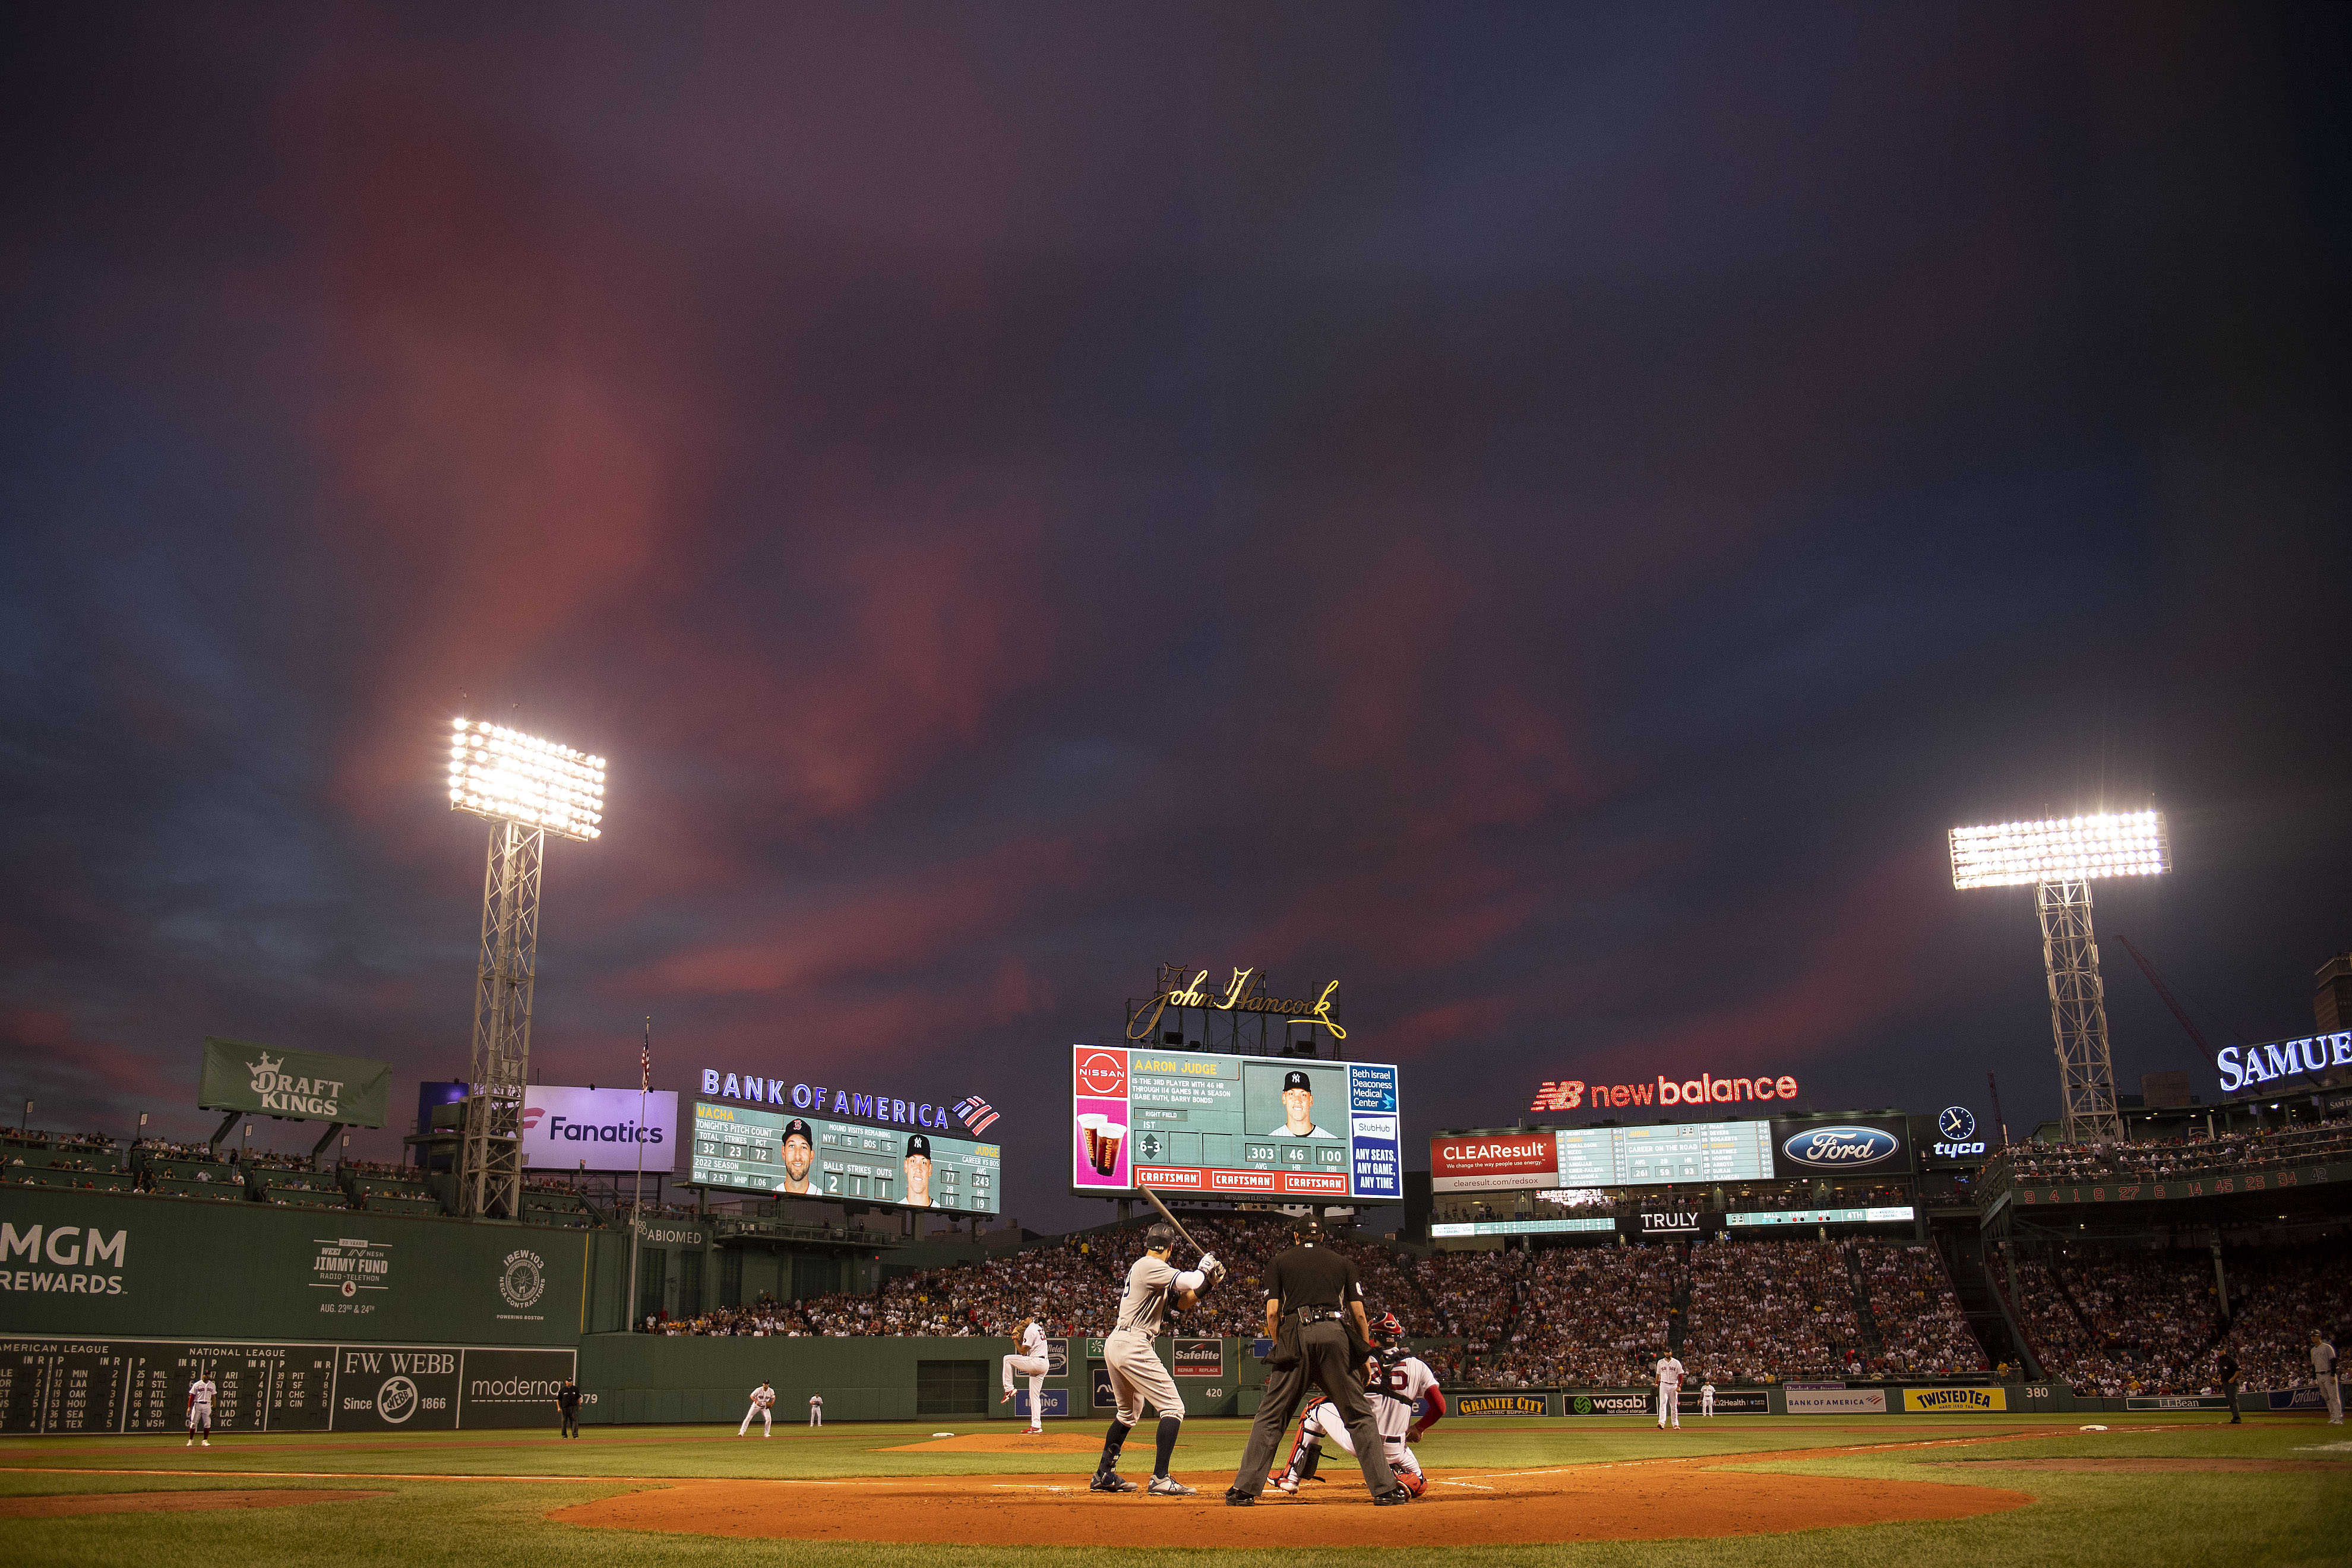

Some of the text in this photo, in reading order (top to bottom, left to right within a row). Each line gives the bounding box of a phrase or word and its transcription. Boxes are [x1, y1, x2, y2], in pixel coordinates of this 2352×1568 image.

[1127, 962, 1347, 1040] John Hancock
[1134, 1060, 1217, 1074] AARON JUDGE
[2217, 1030, 2352, 1092] SAMUE
[1079, 1069, 1125, 1077] NISSAN
[1352, 1069, 1390, 1080] Beth Israel
[251, 1071, 344, 1098] DRAFT
[1353, 1079, 1392, 1089] Deaconess
[1590, 1073, 1798, 1108] new balance
[701, 1068, 949, 1129] BANK OF AMERICA
[1353, 1088, 1382, 1098] Medical
[261, 1090, 337, 1116] KINGS
[1354, 1098, 1379, 1107] Center
[698, 1106, 734, 1121] WACHA
[550, 1116, 663, 1143] Fanatics
[696, 1120, 772, 1137] TONIGHT'S PITCH COUNT
[1359, 1123, 1390, 1132] StubHub
[700, 1132, 719, 1140] TOTAL
[725, 1135, 747, 1144] STRIKES
[703, 1142, 766, 1160] 32 23 72
[975, 1146, 999, 1158] JUDGE
[1443, 1142, 1544, 1160] CLEAResult
[1806, 1133, 1875, 1160] Ford
[1933, 1142, 1985, 1158] tyco
[962, 1156, 983, 1165] CAREER
[1247, 1147, 1341, 1162] .303 46 100
[1356, 1148, 1396, 1162] ANY SEATS,
[695, 1158, 739, 1170] 2022 SEASON
[823, 1162, 892, 1177] BALLS STRIKES OUTS
[1357, 1162, 1396, 1176] ANY GAME,
[713, 1174, 728, 1182] 2.57
[734, 1175, 747, 1184] WHIP
[754, 1178, 766, 1186] 1.06
[830, 1176, 837, 1192] 2
[973, 1176, 989, 1186] .243
[1141, 1172, 1197, 1183] CRAFTSMAN
[1216, 1175, 1270, 1186] CRAFTSMAN
[1289, 1178, 1342, 1188] CRAFTSMAN
[1360, 1177, 1393, 1189] ANY TIME
[1454, 1177, 1538, 1187] clearesult.com/redsox
[2119, 1172, 2297, 1200] 27 6 14 45 26 34
[1641, 1212, 1697, 1228] TRULY
[1847, 1210, 1863, 1220] 4TH
[647, 1229, 701, 1244] ABIOMED
[0, 1223, 127, 1267] MGM
[314, 1256, 388, 1273] JIMMY FUND
[504, 1250, 544, 1269] IBEW 103
[507, 1278, 545, 1308] CONTRACTORS
[339, 1304, 352, 1313] 23RD
[1175, 1350, 1219, 1360] Safelite
[344, 1353, 454, 1374] F.W. WEBB
[72, 1370, 88, 1378] MIN
[1206, 1389, 1222, 1397] 420
[1917, 1390, 1990, 1408] TWISTED TEA
[2025, 1387, 2048, 1398] 380
[343, 1398, 445, 1409] Since 1866
[1460, 1397, 1544, 1414] GRANITE CITY
[1594, 1395, 1646, 1409] wasabi
[2160, 1399, 2199, 1408] L.L.Bean
